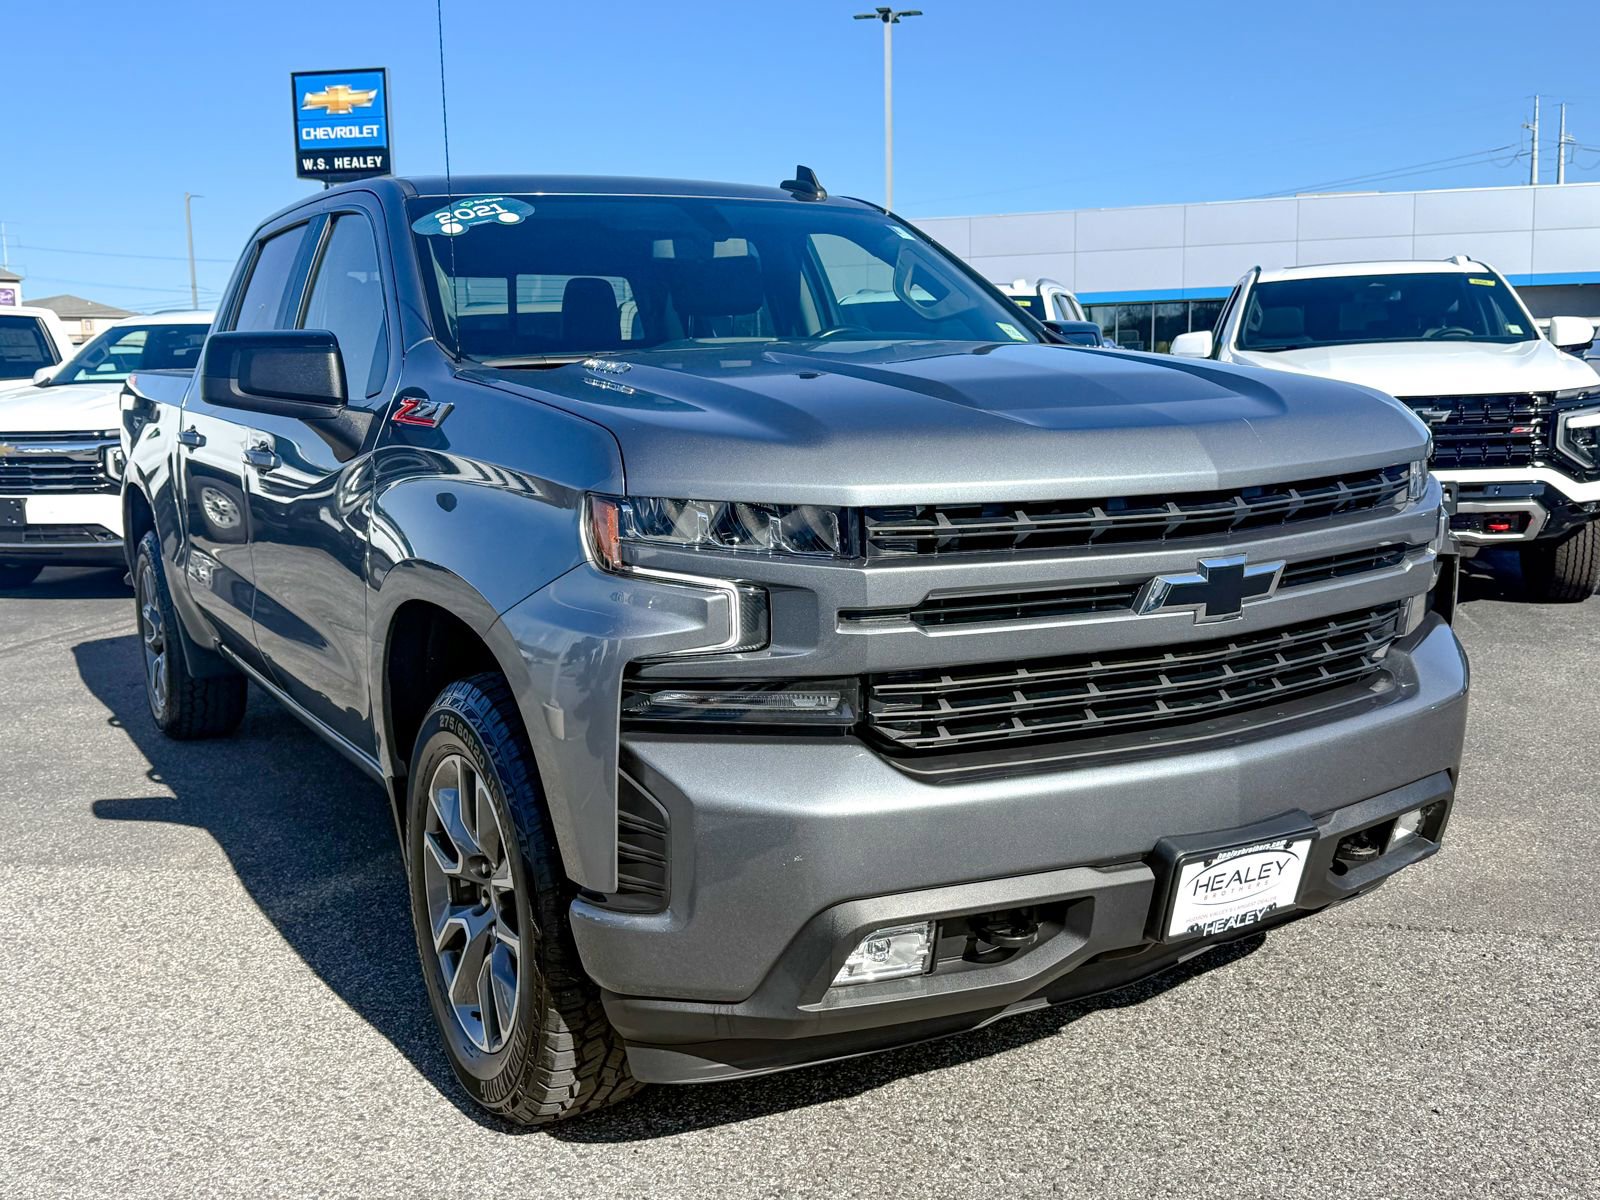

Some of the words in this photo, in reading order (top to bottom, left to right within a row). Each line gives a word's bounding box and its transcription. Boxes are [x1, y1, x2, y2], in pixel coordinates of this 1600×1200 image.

[302, 125, 380, 140] CHEVROLET
[302, 158, 329, 170] W.S.
[334, 156, 382, 169] HEALEY
[435, 203, 508, 225] 2021
[391, 396, 455, 428] Z71
[439, 713, 486, 770] 275/60R20
[1193, 857, 1291, 896] HEALEY
[1203, 880, 1268, 901] BROTHERS
[1203, 907, 1265, 936] HEALEY
